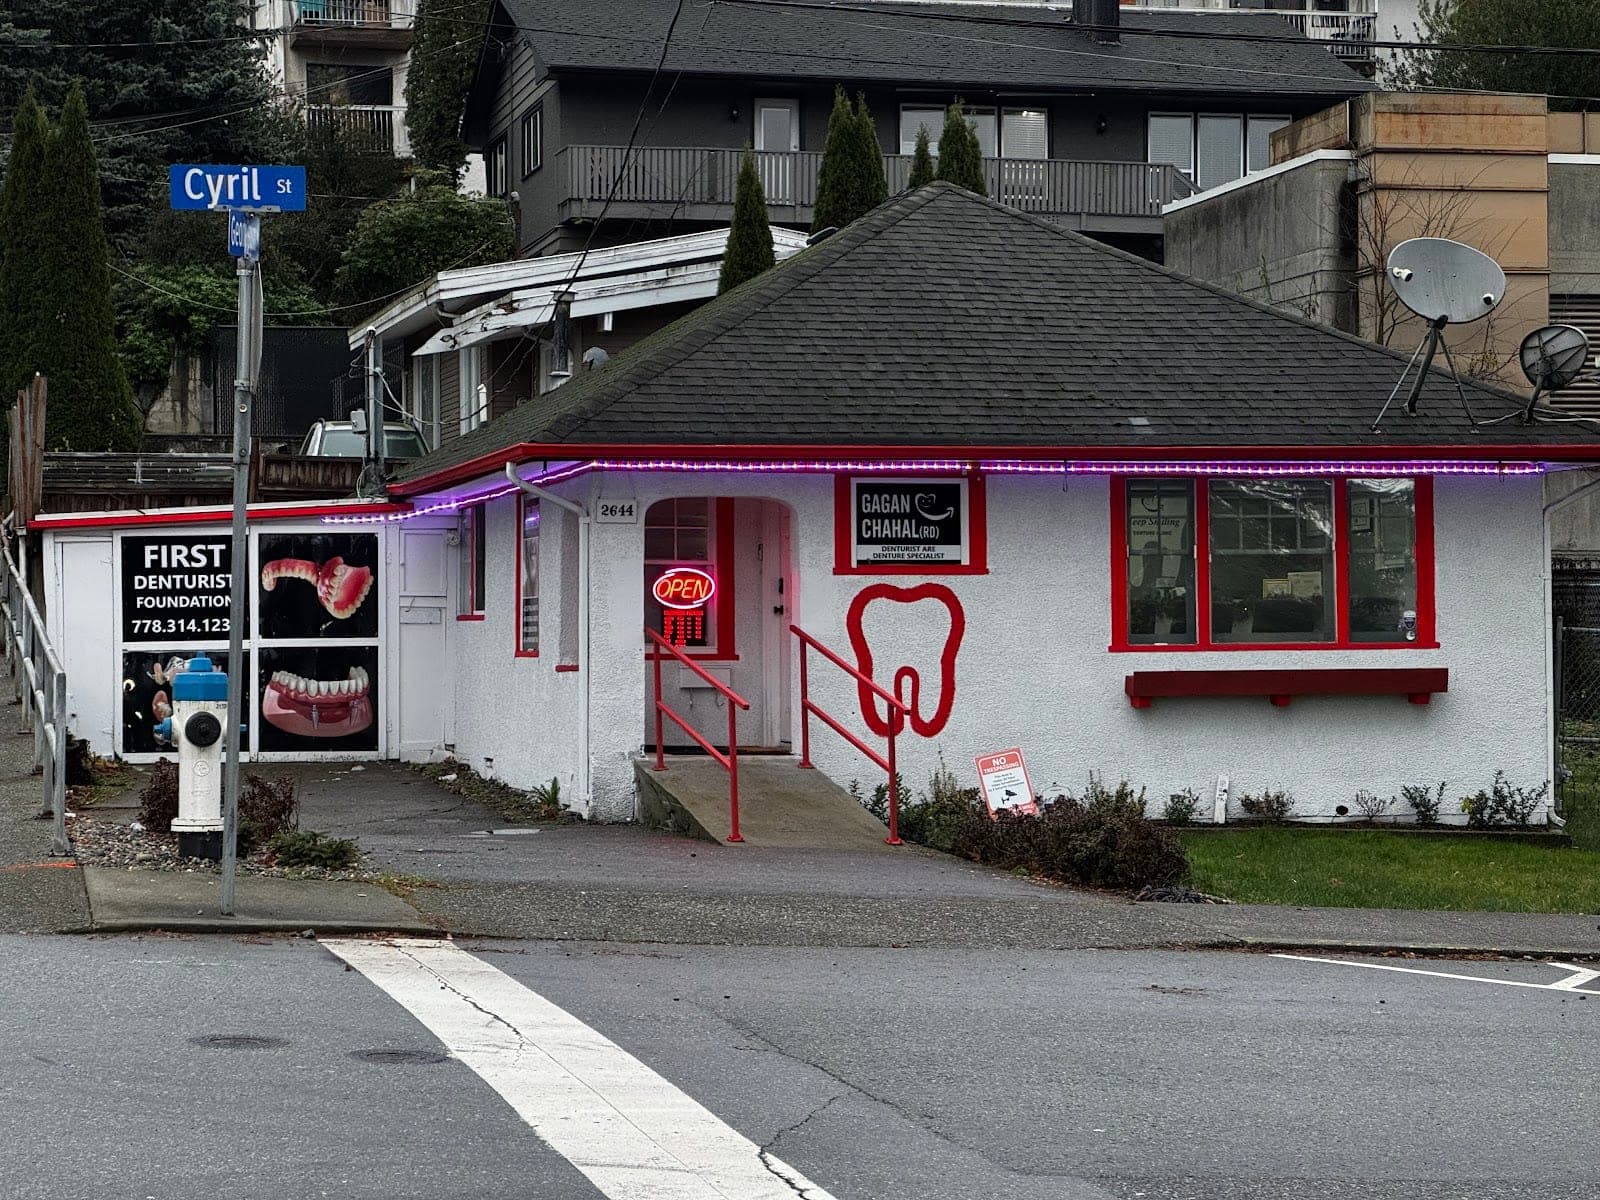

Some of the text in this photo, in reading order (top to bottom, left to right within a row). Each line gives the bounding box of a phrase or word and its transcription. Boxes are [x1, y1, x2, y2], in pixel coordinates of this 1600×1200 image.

[184, 166, 292, 209] Cyril St
[601, 504, 634, 516] 2644
[861, 494, 911, 513] GAGAN
[144, 544, 227, 569] FIRST
[872, 552, 945, 560] DENTURE SPECIALIST
[881, 545, 920, 553] DENTURIST
[134, 573, 233, 590] DENTURIST
[657, 579, 710, 599] OPEN
[136, 595, 232, 609] FOUNDATION
[131, 618, 231, 634] 778.314.123
[992, 756, 1007, 767] NO
